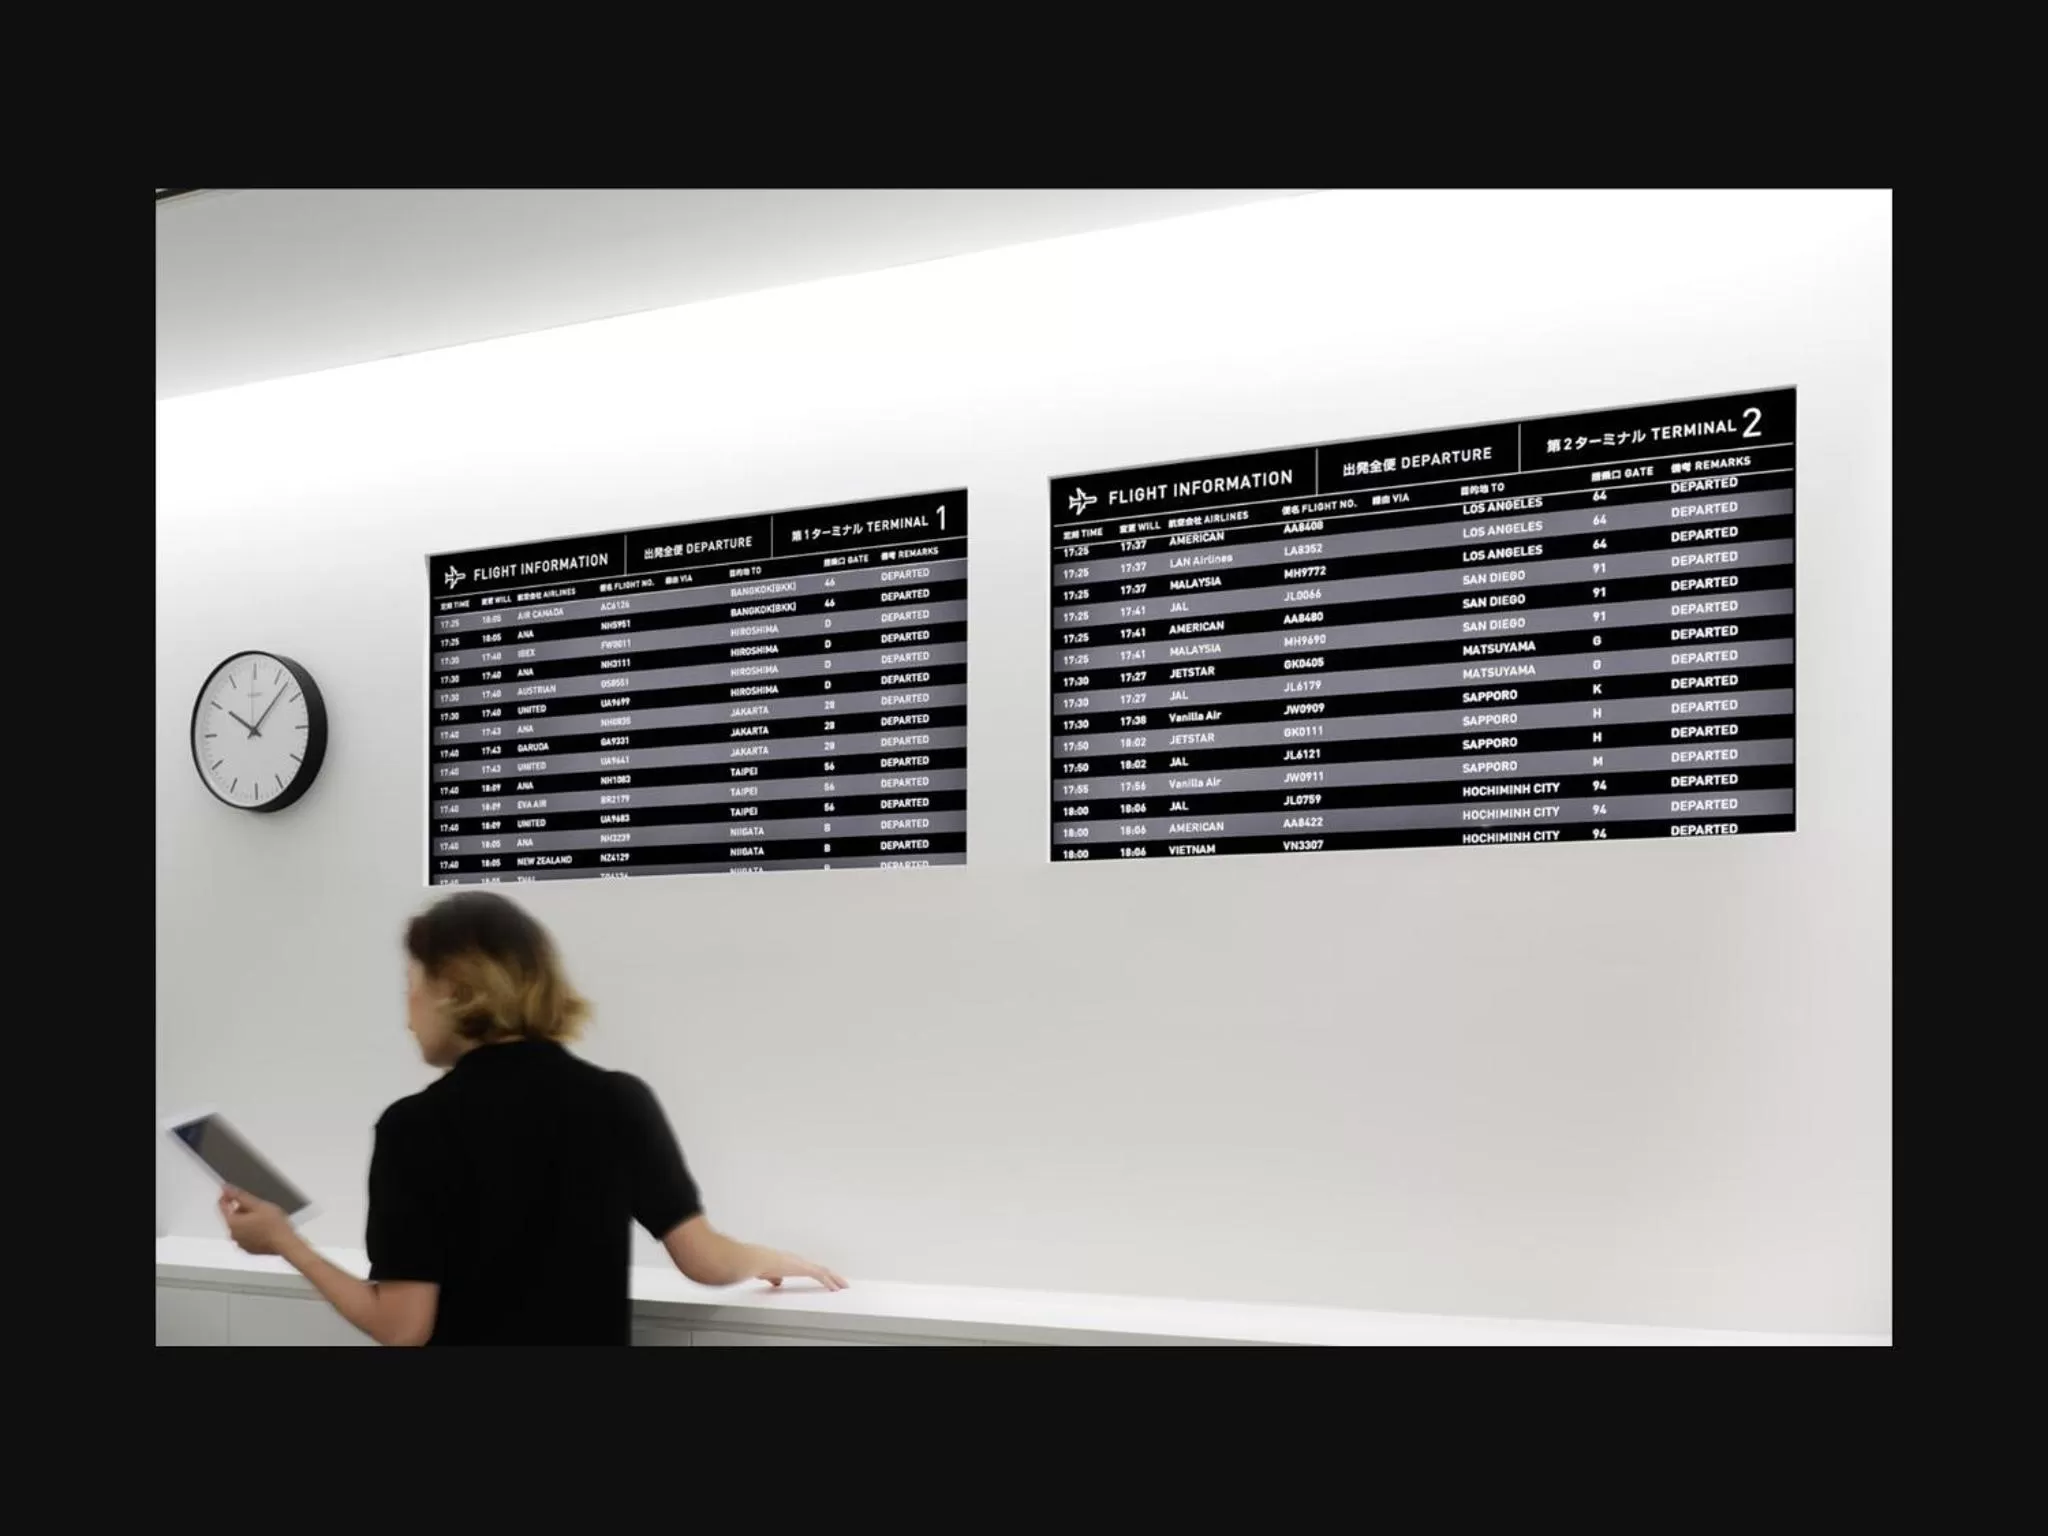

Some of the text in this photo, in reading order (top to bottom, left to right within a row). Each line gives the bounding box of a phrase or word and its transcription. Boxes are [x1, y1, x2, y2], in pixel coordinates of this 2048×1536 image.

[1546, 407, 1761, 453] 第2ターミナル TERMINAL 2
[1343, 446, 1492, 477] 出発全便 DEPARTURE
[1081, 527, 1103, 537] TIME
[1137, 521, 1161, 531] WILL
[1203, 510, 1249, 524] AIRLINES
[1301, 500, 1337, 513] FLIGHT
[1339, 498, 1357, 509] NO.
[1392, 492, 1410, 503] VIA
[1490, 482, 1505, 492] TO
[1624, 465, 1654, 478] GATE
[1694, 455, 1751, 470] REMARKS
[1109, 469, 1292, 505] FLIGHT INFORMATION
[791, 505, 945, 542] 第1ターミナル TERMINAL 1
[1063, 477, 1738, 557] 17:25 17:37 AMERICAN LOS ANGELES 64 DEPARTED
[644, 535, 752, 560] 出発全便 DEPARTURE
[1063, 567, 1089, 579] 17:25
[1120, 561, 1147, 573] 17:37
[1169, 556, 1191, 568] LAN
[1462, 526, 1486, 538] LOS
[1488, 520, 1543, 536] ANGELES
[1592, 514, 1606, 526] 64
[1671, 501, 1738, 518] DEPARTED
[473, 553, 608, 581] FLIGHT INFORMATION
[880, 567, 930, 581] DEPARTED
[1063, 589, 1089, 600] 17:25
[1120, 583, 1147, 595] 17:37
[1170, 576, 1222, 590] MALAYSIA
[1462, 549, 1486, 562] LOS
[1488, 544, 1543, 559] ANGELES
[1592, 538, 1607, 550] 64
[1670, 525, 1738, 542] DEPARTED
[880, 588, 930, 602] DEPARTED
[1063, 550, 1738, 622] 17:25 17:41 JAL SAN DIEGO 91 DEPARTED
[881, 609, 929, 623] DEPARTED
[1063, 632, 1089, 643] 17:25
[1120, 627, 1146, 638] 17:41
[1168, 620, 1224, 634] AMERICAN
[1462, 596, 1485, 609] SAN
[1489, 593, 1526, 607] DIEGO
[1592, 586, 1606, 598] 91
[1670, 575, 1739, 591] DEPARTED
[730, 630, 930, 657] HIROSHIMA DEPARTED
[1064, 600, 1738, 665] 17:25 17:41 MALAYSIA SAN DIEGO 91 DEPARTED
[1063, 675, 1089, 687] 17:30
[1120, 671, 1147, 682] 17:27
[1169, 665, 1215, 679] JETSTAR
[1462, 640, 1536, 656] MATSUYAMA
[1670, 624, 1739, 640] DEPARTED
[517, 672, 930, 715] UNITED HIROSHIMA DEPARTED
[1063, 649, 1738, 708] 17:30 17:27 JAL MATSUYAMA DEPARTED
[730, 692, 929, 717] JAKARTA DEPARTED
[1063, 719, 1089, 730] 17:30
[1120, 714, 1147, 726] 17:38
[1168, 711, 1204, 722] Vanilla
[1205, 710, 1222, 720] Air
[1462, 689, 1518, 703] SAPPORO
[1592, 683, 1602, 694] K
[1670, 674, 1739, 689] DEPARTED
[730, 713, 930, 737] JAKARTA DEPARTED
[1063, 699, 1738, 751] 17:50 18:02 JETSTAR SAPPORO H DEPARTED
[730, 755, 930, 776] TAIPEI DEPARTED
[1063, 762, 1089, 773] 17:50
[1120, 758, 1147, 770] 18:02
[1169, 756, 1189, 767] JAL
[1462, 736, 1518, 750] SAPPORO
[1592, 731, 1602, 742] H
[1670, 724, 1739, 738] DEPARTED
[730, 776, 929, 796] TAIPEI DEPARTED
[1063, 748, 1738, 794] 17:55 17:56 Vanilla Air SAPPORO M DEPARTED
[880, 797, 929, 809] DEPARTED
[1063, 805, 1089, 816] 18:00
[1120, 802, 1147, 813] 18:06
[1169, 801, 1189, 811] JAL
[1462, 783, 1530, 797] HOCHIMINH
[1533, 782, 1560, 794] CITY
[1592, 779, 1607, 791] 94
[1670, 773, 1738, 787] DEPARTED
[1063, 798, 1738, 838] 18:00 18:06 AMERICAN HOCHIMINH CITY 94 DEPARTED
[880, 839, 929, 850] DEPARTED
[1063, 849, 1089, 859] 18:00
[1120, 846, 1147, 857] 18:06
[1168, 844, 1216, 855] VIETNAM
[1462, 831, 1530, 843] HOCHIMINH
[1533, 830, 1560, 841] CITY
[1592, 828, 1607, 839] 94
[1670, 822, 1738, 836] DEPARTED
